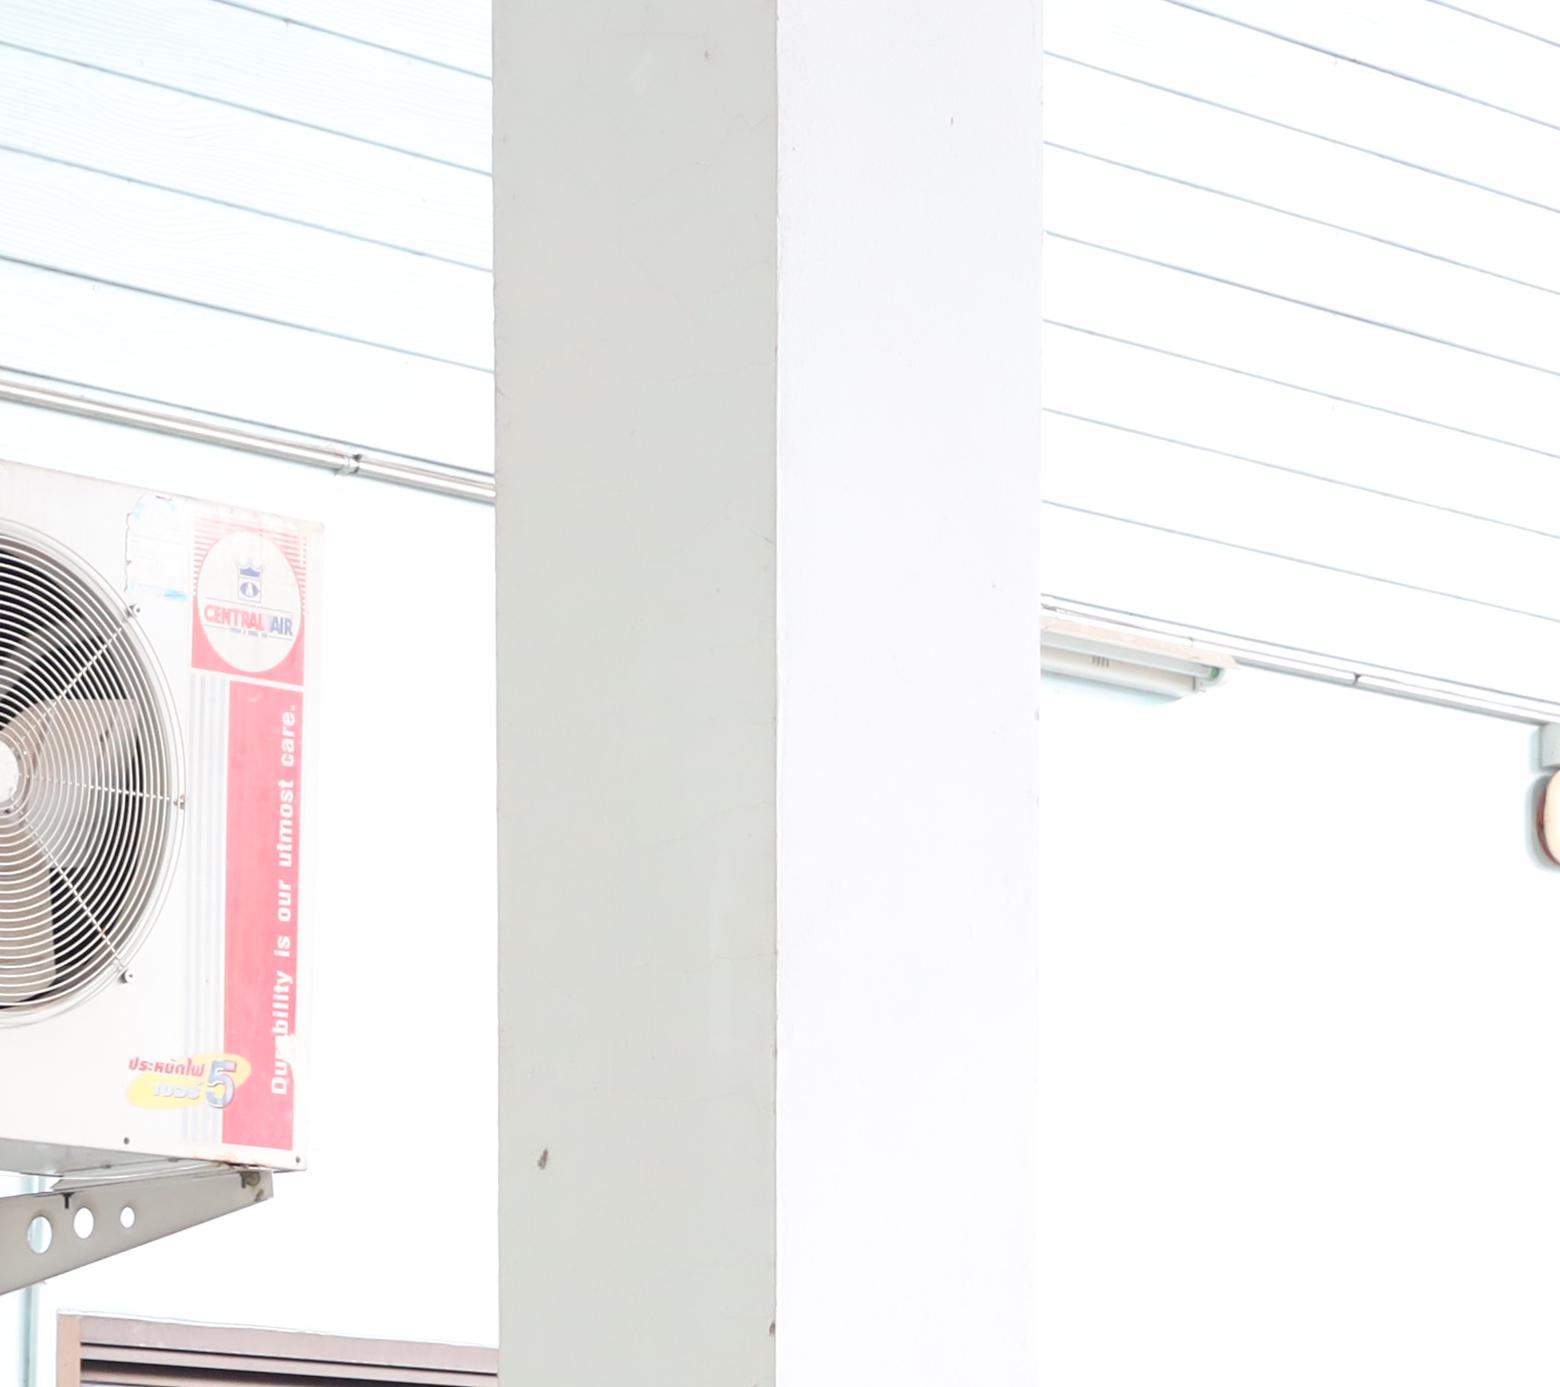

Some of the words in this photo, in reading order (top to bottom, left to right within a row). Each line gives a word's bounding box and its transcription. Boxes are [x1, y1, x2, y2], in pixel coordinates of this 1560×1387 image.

[203, 604, 265, 632] CENTRAL
[270, 615, 294, 637] AIR
[281, 704, 296, 768] care.
[277, 779, 295, 868] utmost
[277, 879, 293, 923] our
[273, 935, 291, 958] is
[205, 1059, 238, 1109] 5
